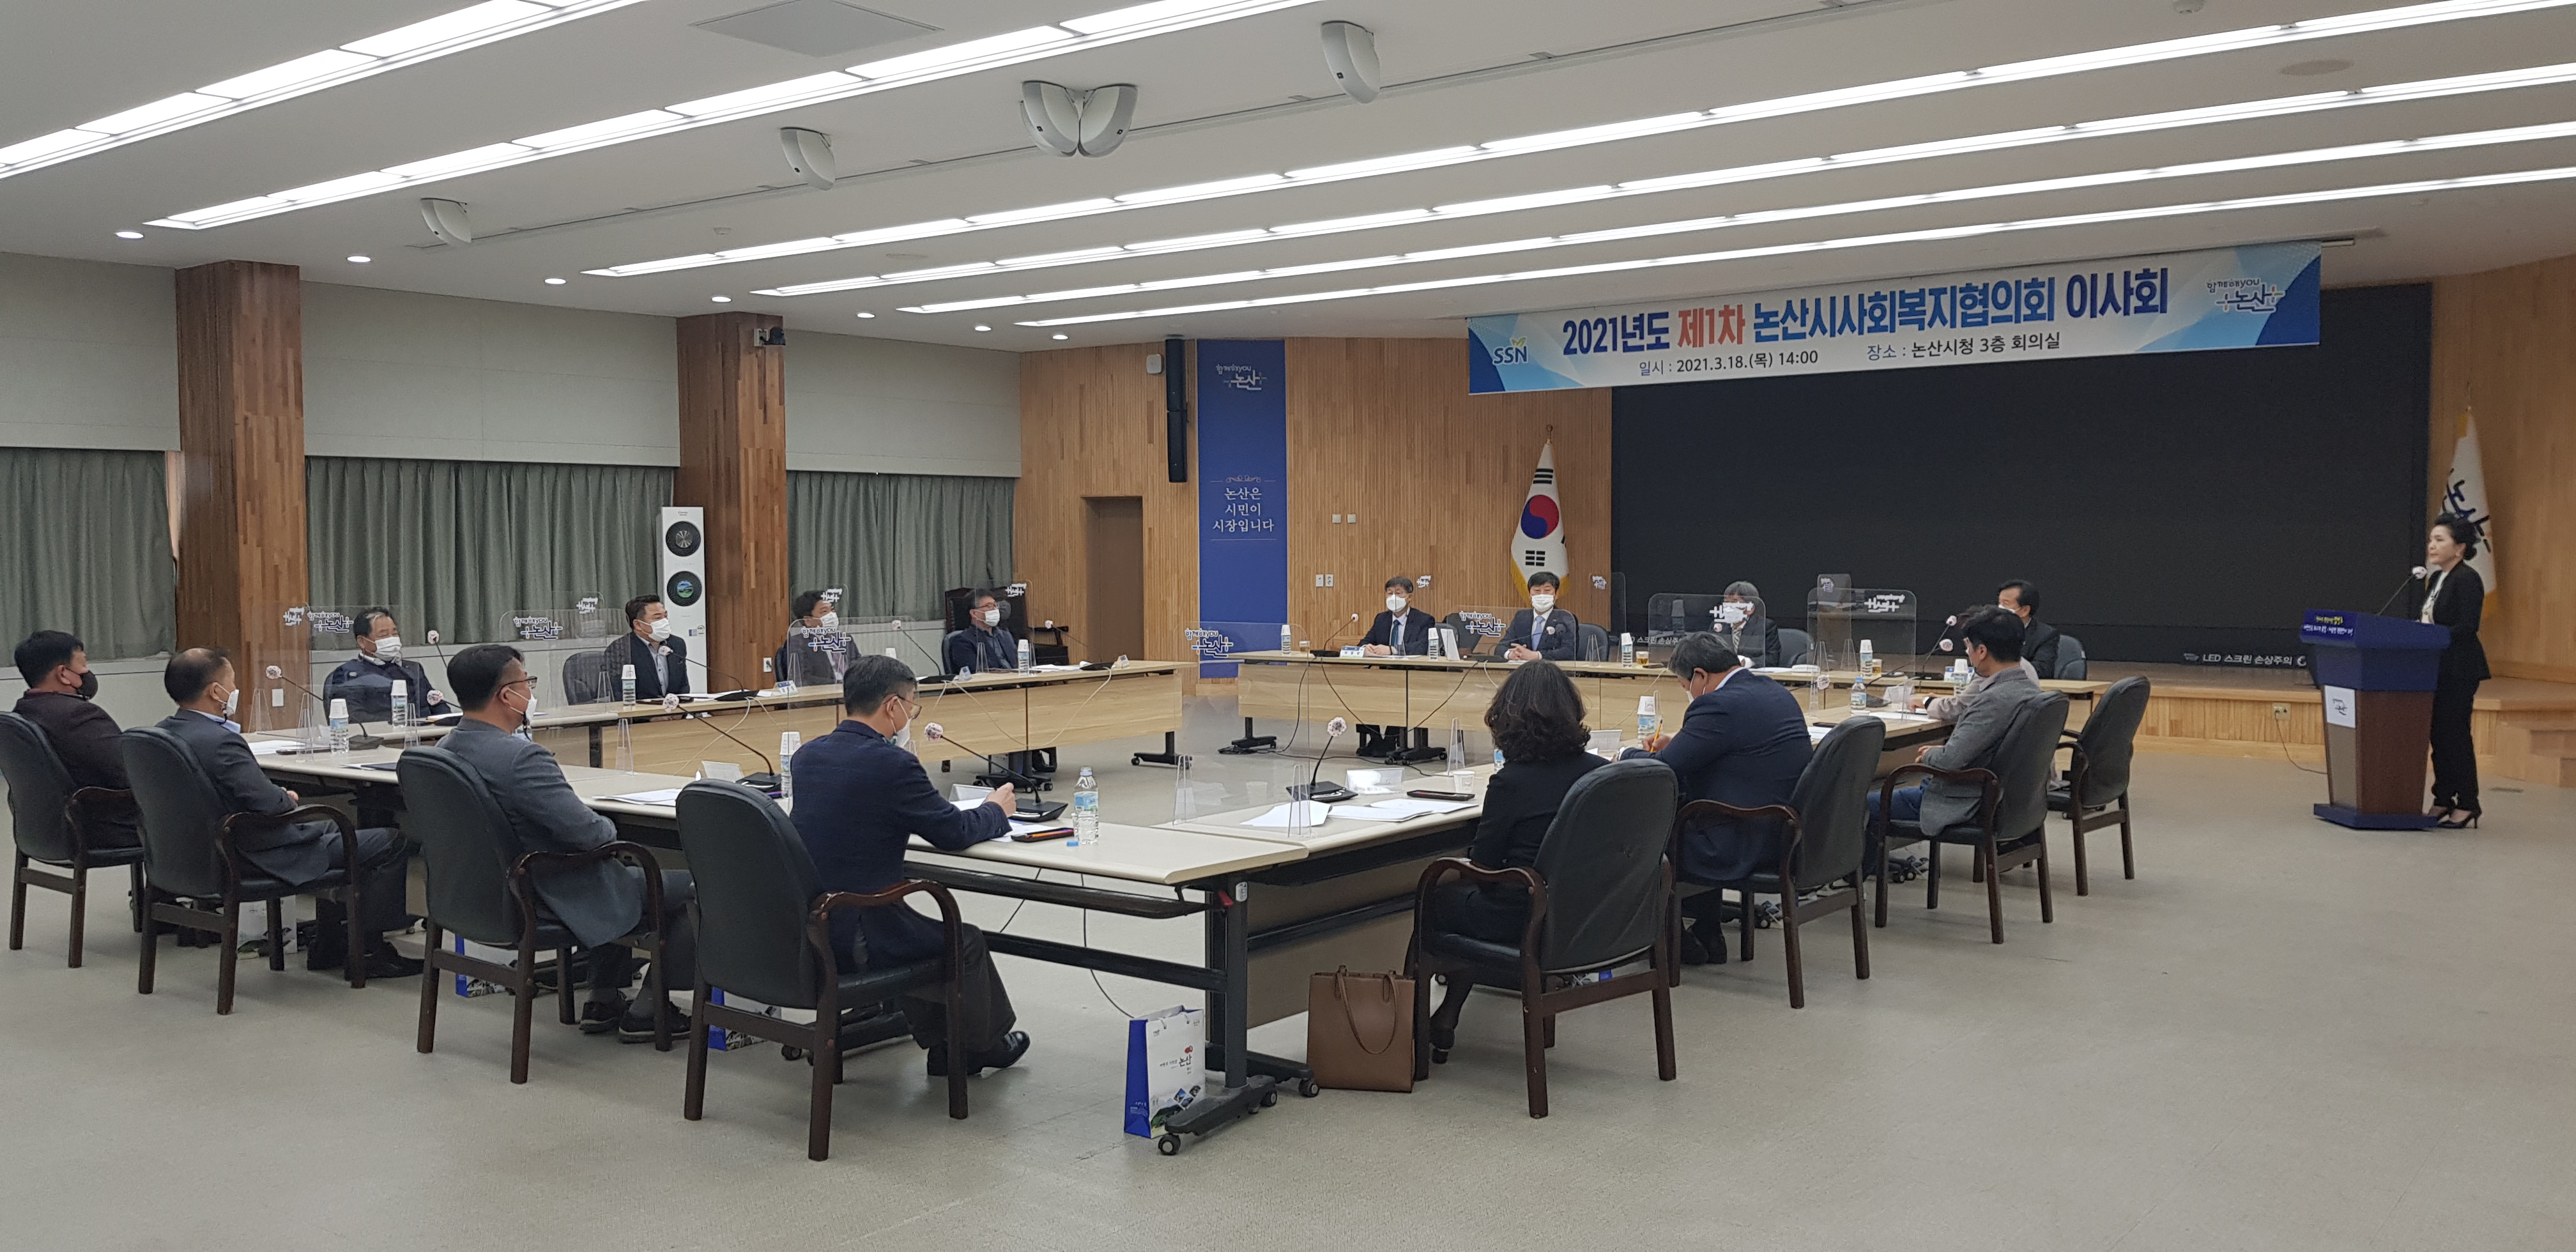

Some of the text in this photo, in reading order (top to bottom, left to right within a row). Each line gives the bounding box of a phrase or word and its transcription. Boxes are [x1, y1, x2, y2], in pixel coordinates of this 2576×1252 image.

[2219, 284, 2281, 312] 논산
[1562, 267, 2168, 355] 2021년도 제1차 논산시사회복지협의회 이사회
[1494, 346, 1528, 364] SSN
[1867, 344, 1897, 361] 장소
[1911, 337, 1974, 358] 논산시청
[1979, 335, 2006, 353] 3층
[2011, 332, 2061, 351] 회의실
[1639, 360, 1664, 376] 일시
[1676, 352, 1774, 373] 2021.3.18.(목)
[1778, 350, 1819, 366] 14:00
[1227, 370, 1264, 390] 논산
[1224, 487, 1262, 500] 논산은
[1225, 503, 1261, 516] 시민이
[1213, 519, 1275, 533] 시장입니다
[2203, 653, 2293, 666] LED 스크린 손상주의
